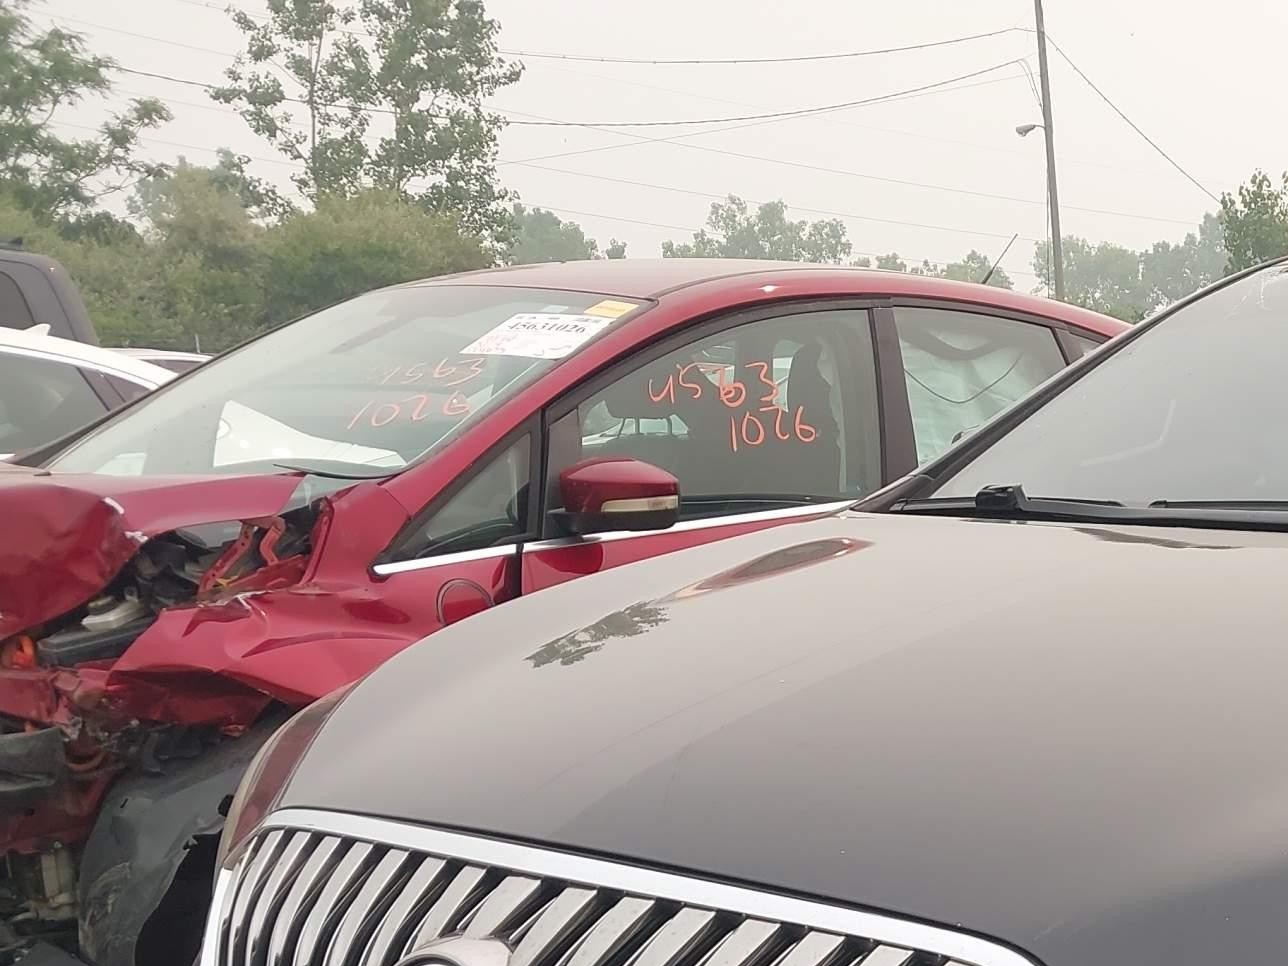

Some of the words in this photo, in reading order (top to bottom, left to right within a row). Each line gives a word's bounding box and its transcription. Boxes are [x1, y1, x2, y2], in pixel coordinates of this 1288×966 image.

[508, 321, 587, 334] 45631026
[649, 361, 780, 408] 4563
[347, 390, 471, 430] 1026
[730, 405, 817, 453] 1026
